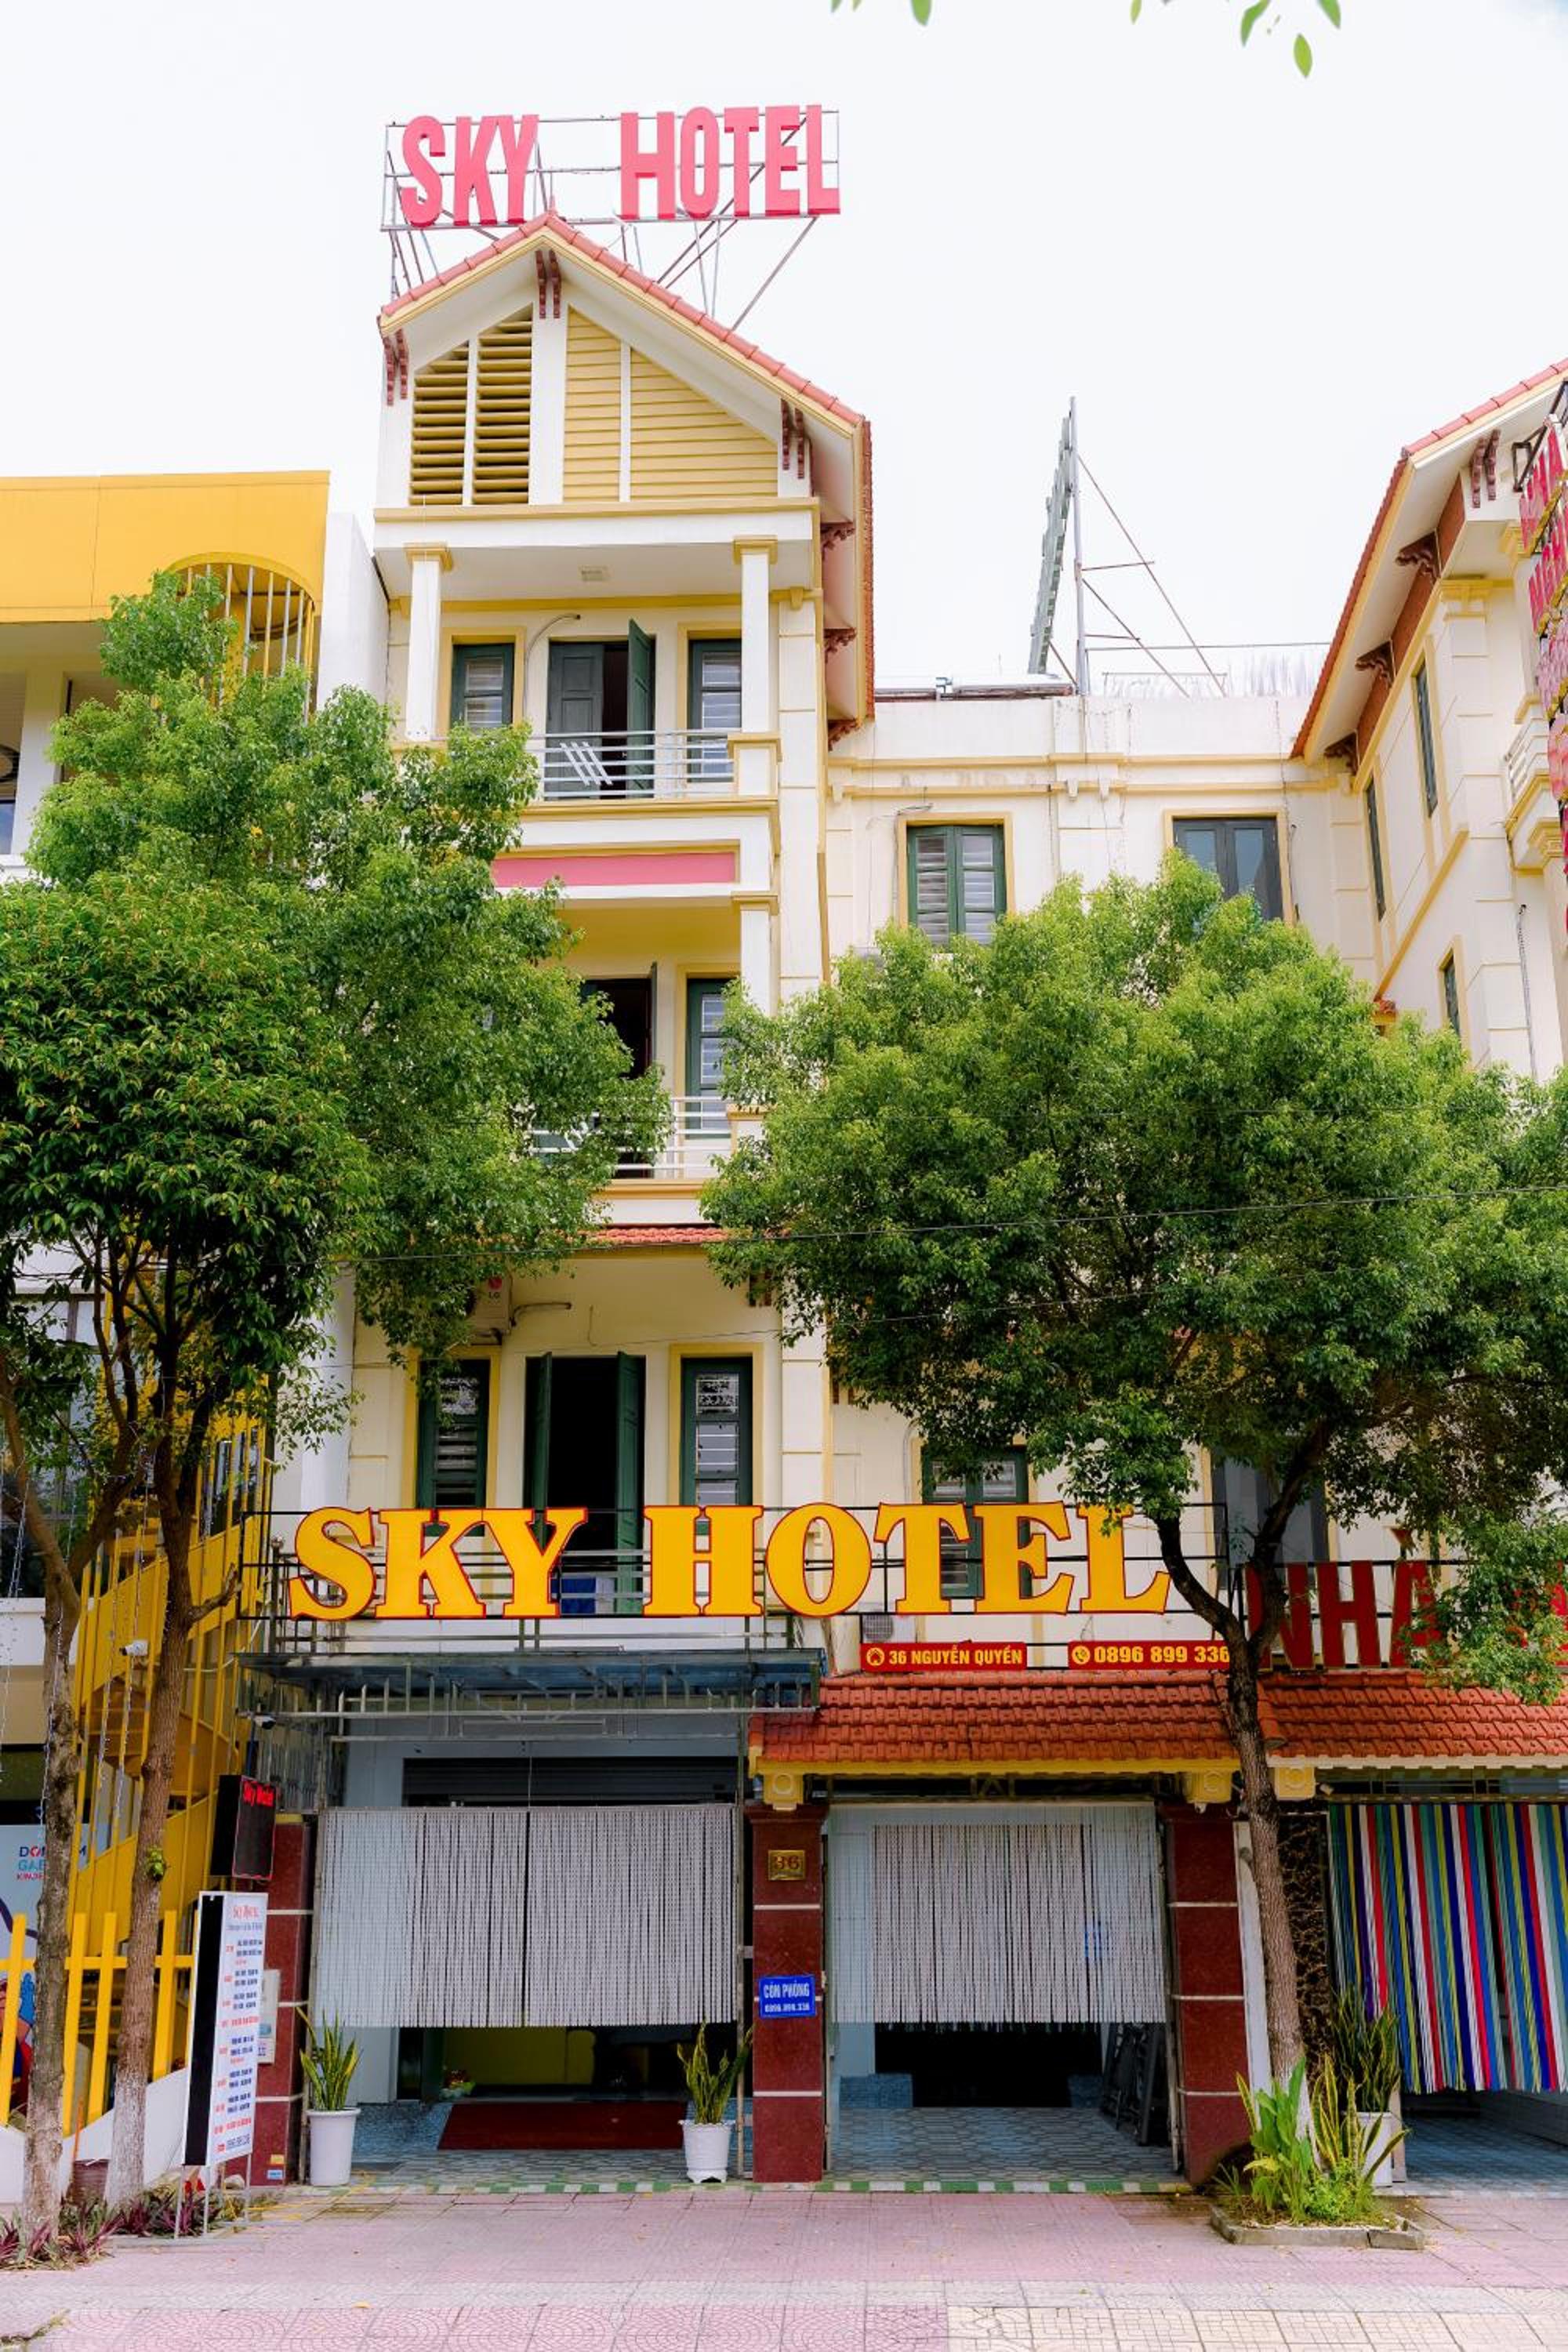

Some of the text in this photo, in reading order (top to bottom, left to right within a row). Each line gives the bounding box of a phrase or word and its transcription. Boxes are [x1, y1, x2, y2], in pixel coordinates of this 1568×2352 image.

[401, 104, 840, 228] SKY HOTEL
[289, 1501, 1172, 1621] SKY HOTEL
[888, 1650, 907, 1664] 36
[1094, 1646, 1230, 1664] 0896 899 336
[774, 1855, 800, 1870] 36
